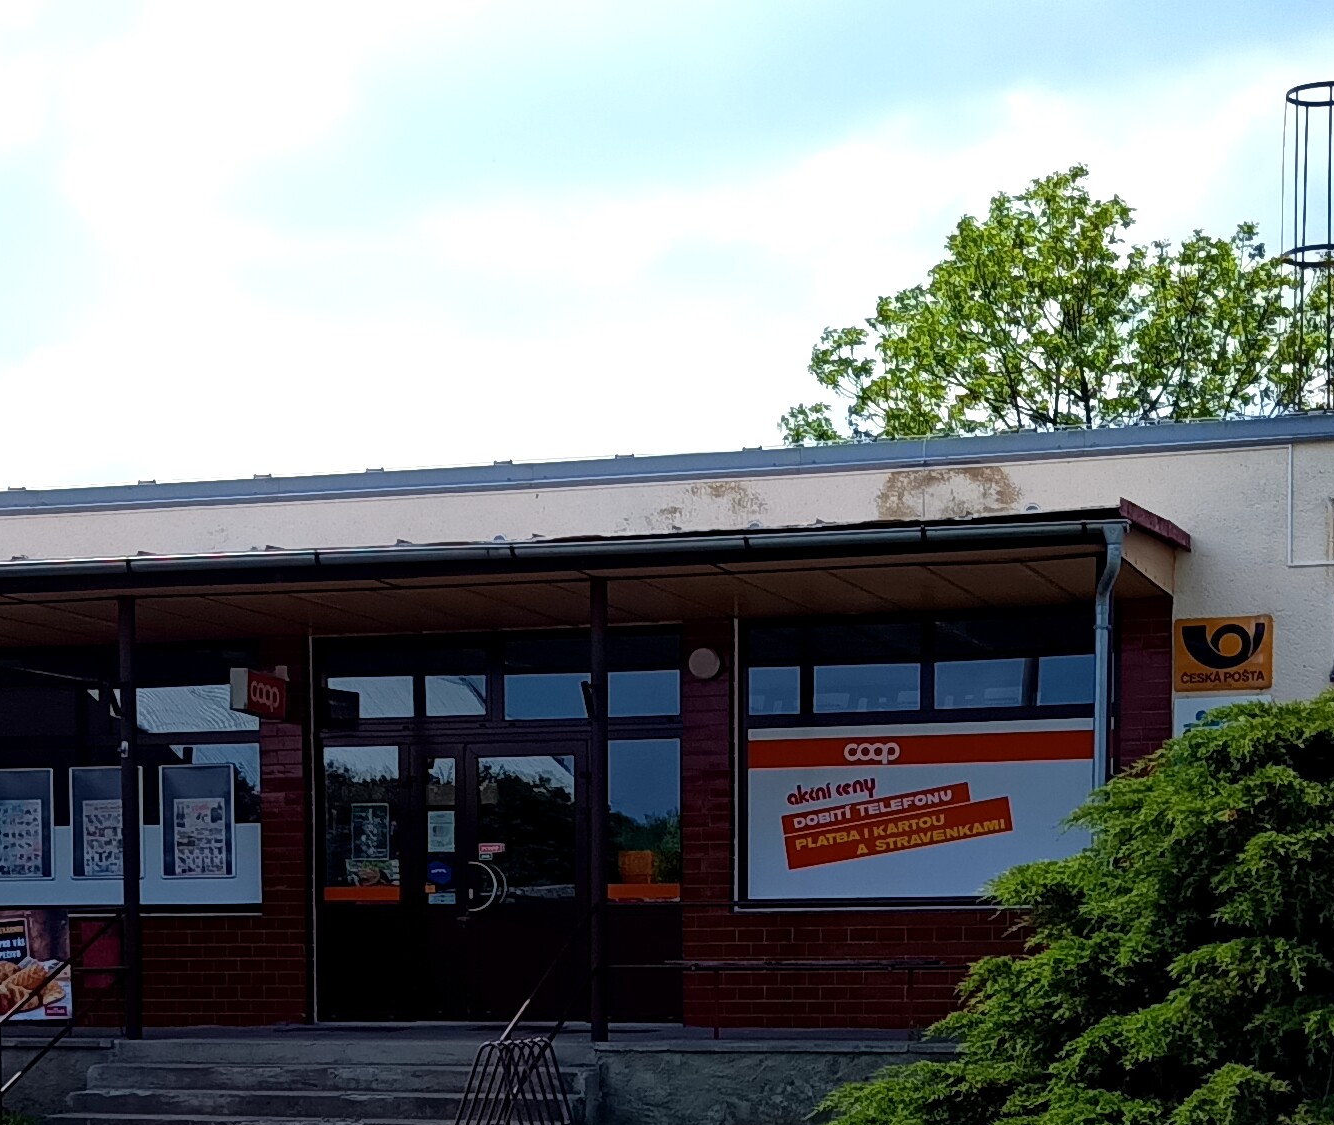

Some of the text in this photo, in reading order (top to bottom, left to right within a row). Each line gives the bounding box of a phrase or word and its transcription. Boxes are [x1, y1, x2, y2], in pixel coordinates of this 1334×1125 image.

[1180, 668, 1265, 685] ČESKÁ POŠTA
[250, 680, 279, 713] coop
[843, 741, 901, 764] coop
[835, 777, 876, 799] ceny
[793, 789, 953, 829] DOBITÍ TELEFONU
[795, 830, 860, 852] PLATBA
[873, 814, 946, 838] KARTOU
[856, 818, 1006, 856] A STRAVENKAMI
